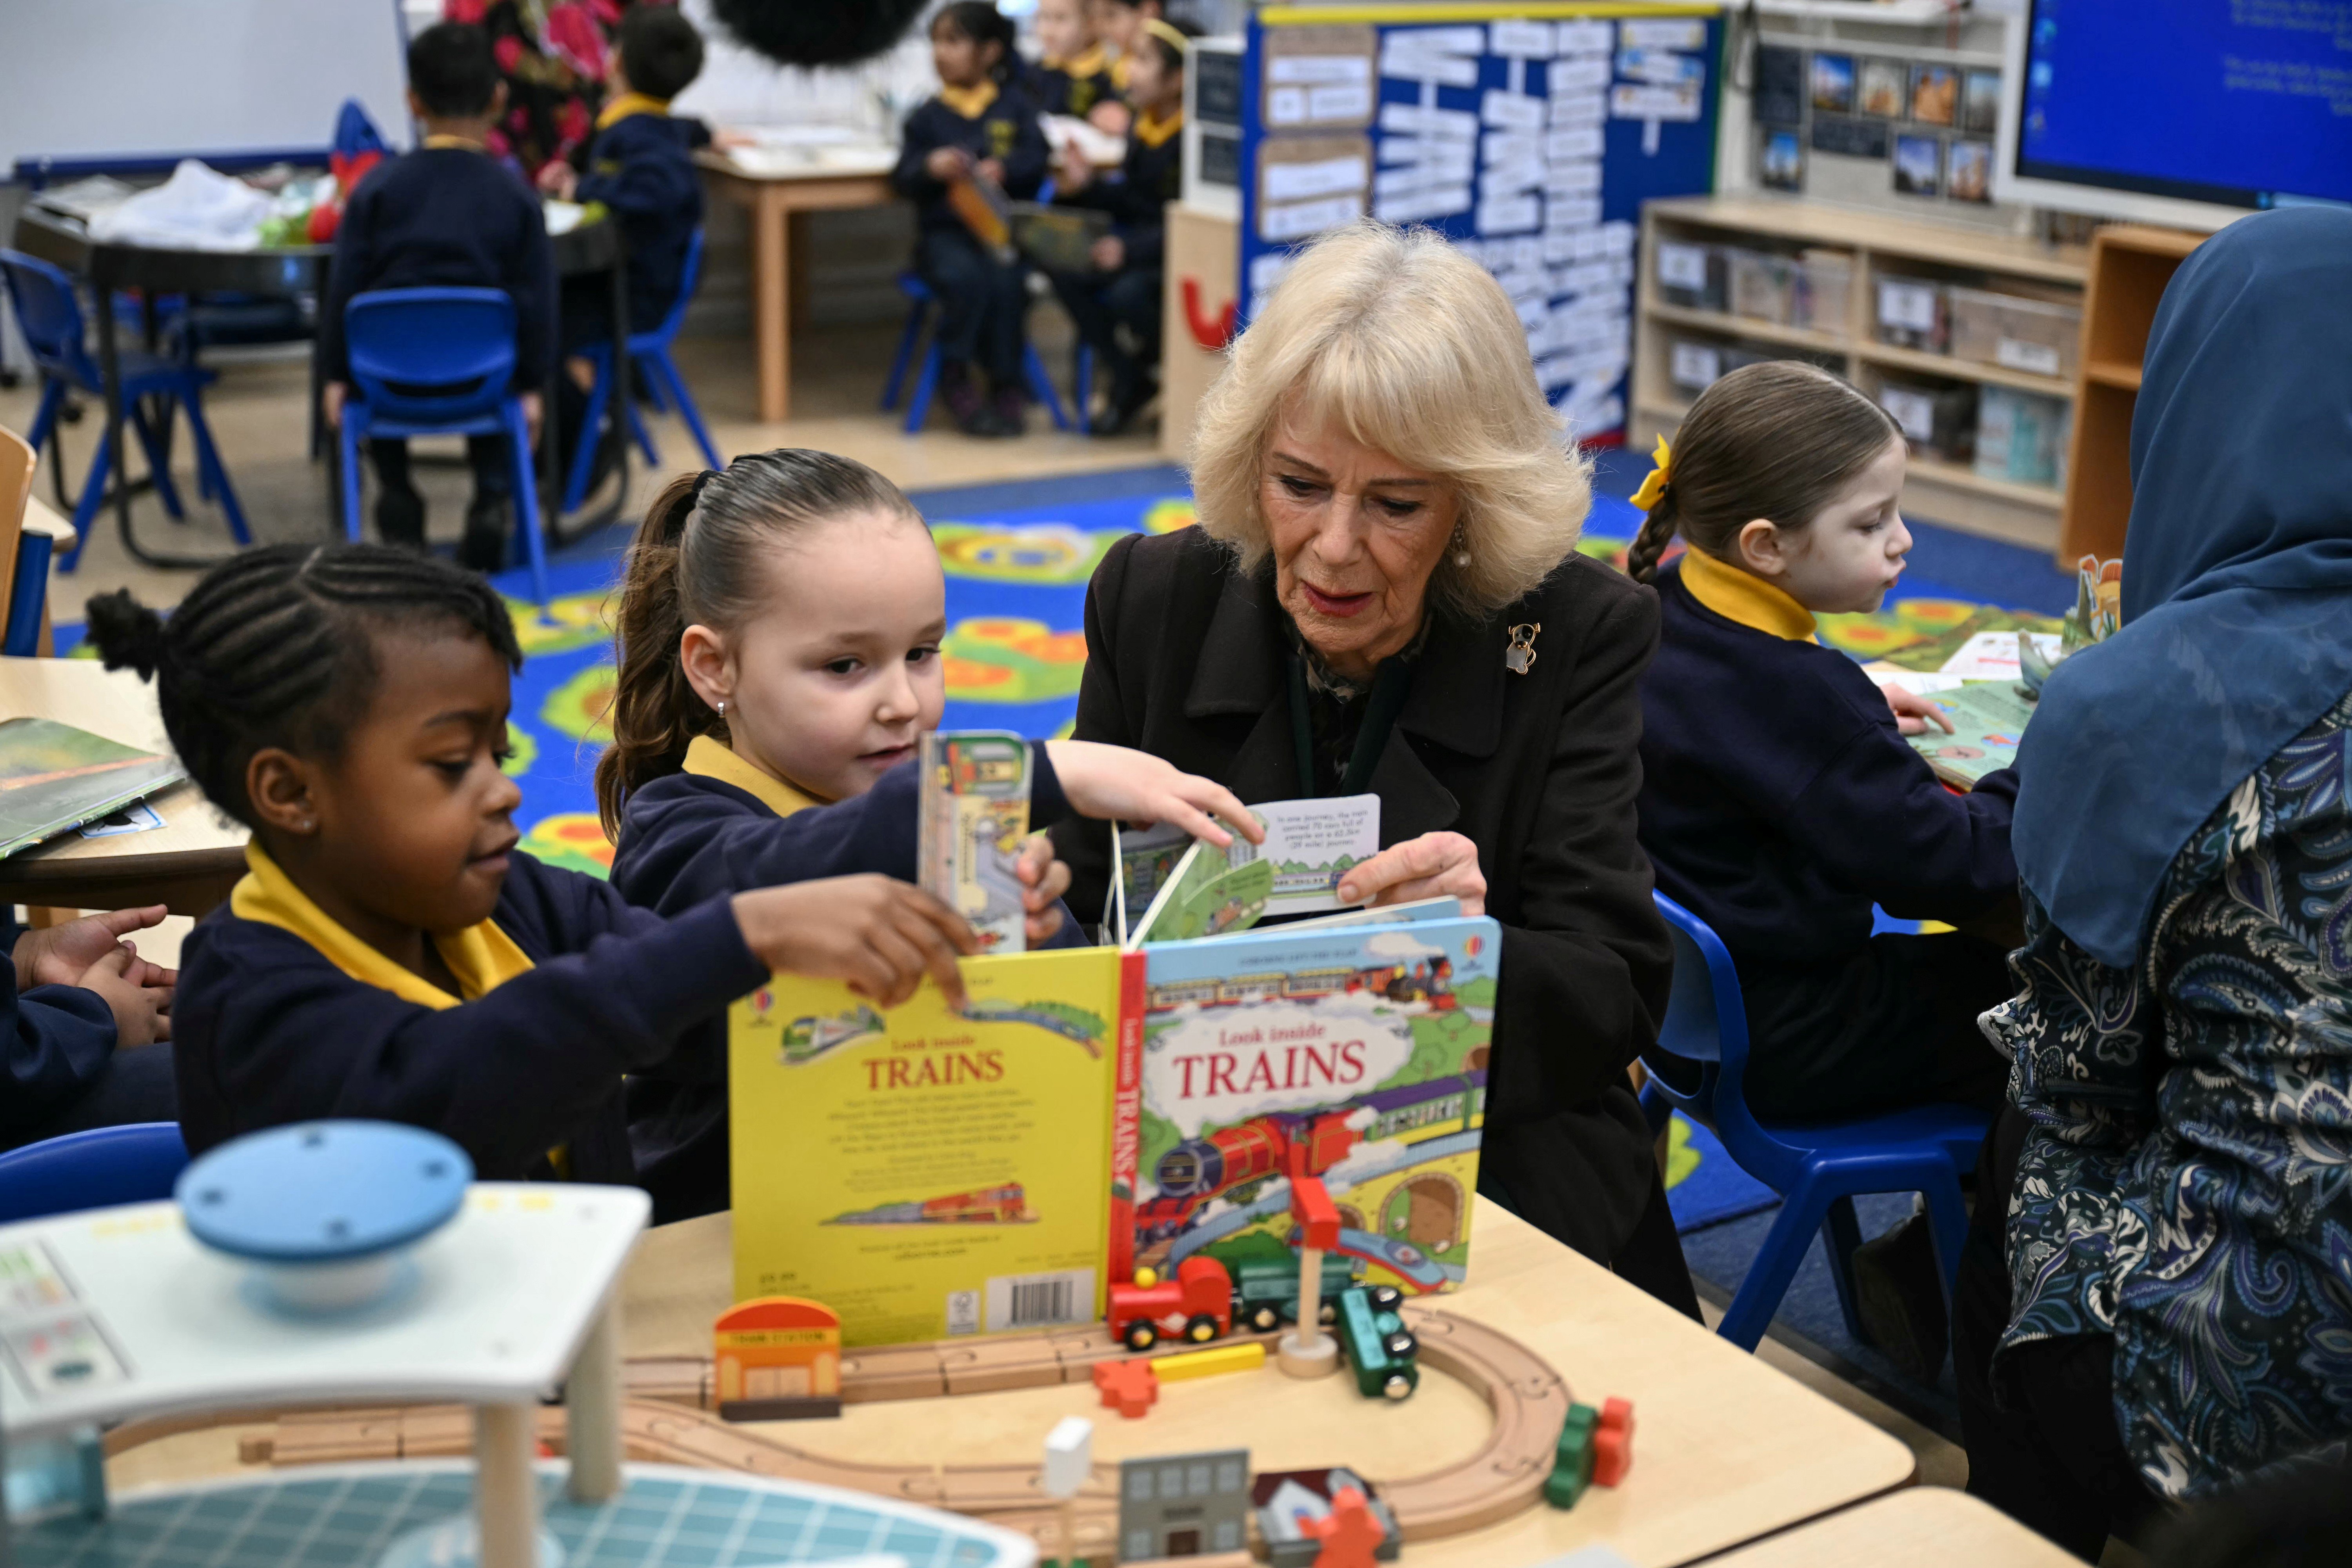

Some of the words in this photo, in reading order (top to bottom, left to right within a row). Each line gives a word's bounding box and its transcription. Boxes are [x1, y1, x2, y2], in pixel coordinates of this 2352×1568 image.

[891, 1038, 926, 1052] Look
[931, 1035, 974, 1049] inside
[1218, 1026, 1263, 1047] Look
[1269, 1021, 1326, 1043] inside
[862, 1049, 1005, 1090] TRAINS
[1171, 1039, 1366, 1099] TRAINS
[1114, 1088, 1139, 1174] TRAINS
